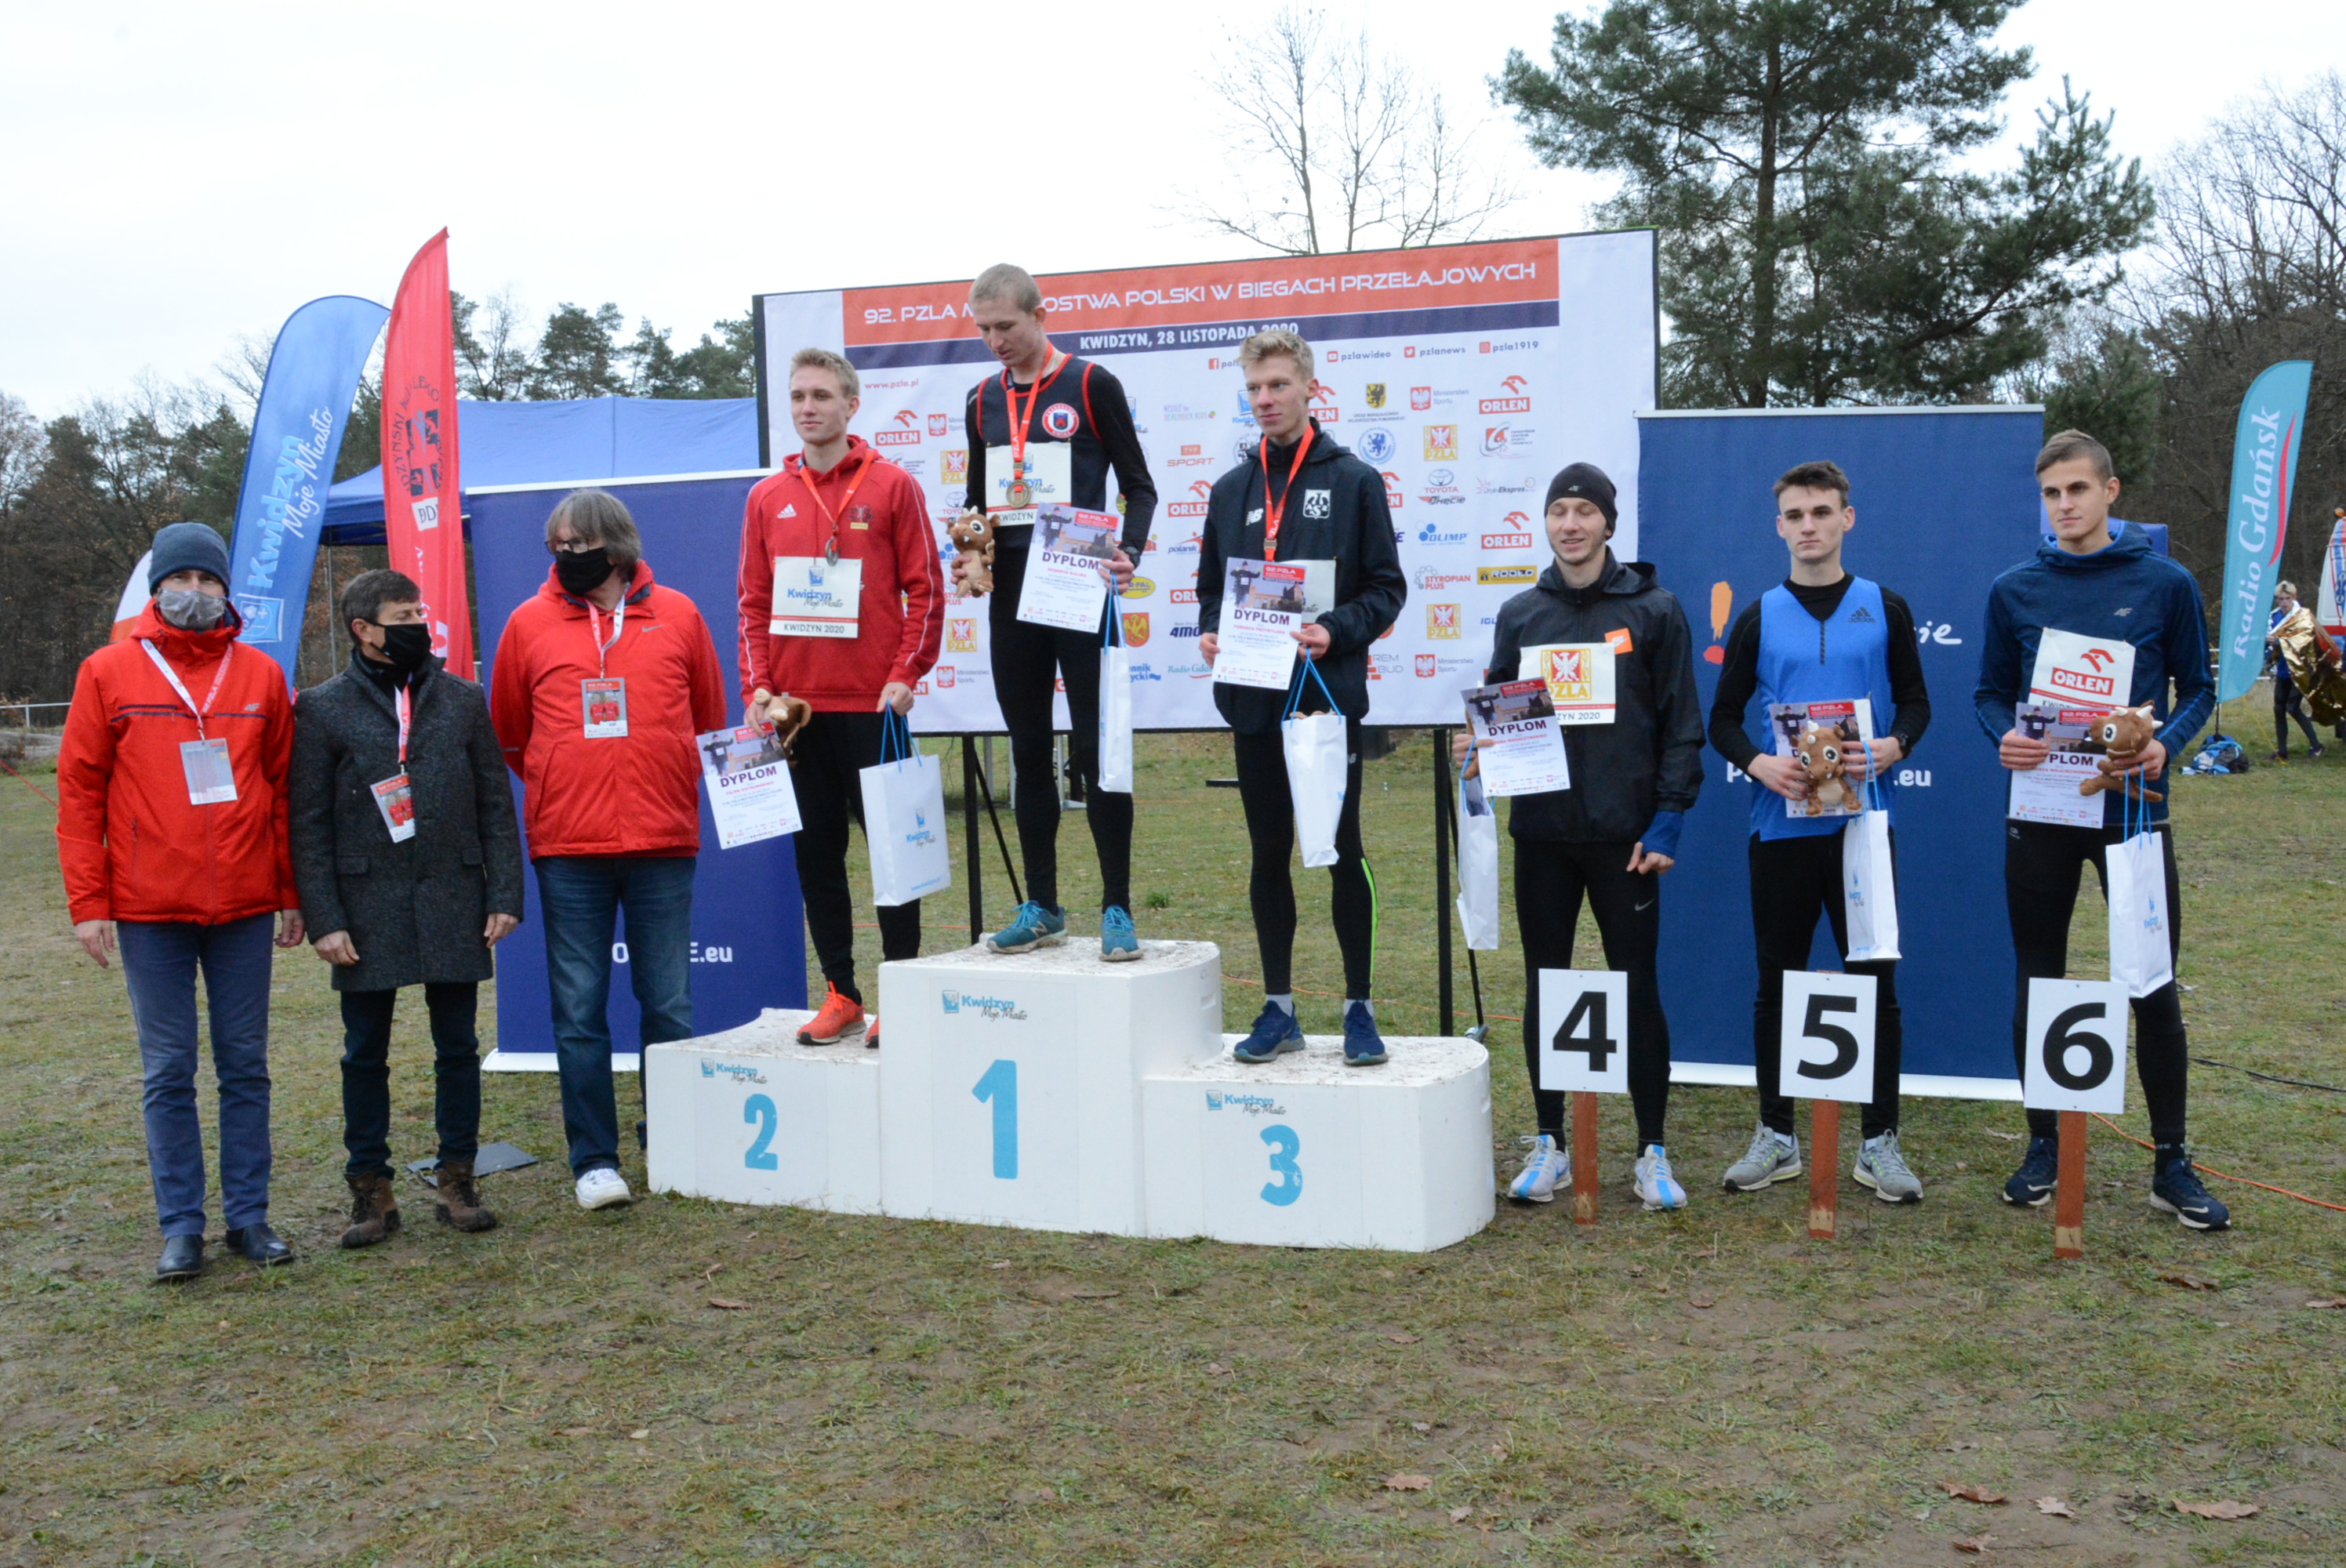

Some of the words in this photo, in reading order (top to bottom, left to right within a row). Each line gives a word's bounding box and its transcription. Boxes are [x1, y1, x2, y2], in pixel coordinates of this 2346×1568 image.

[864, 307, 896, 325] 92.
[901, 303, 957, 321] PZLA
[1126, 285, 1205, 306] POLSKI
[1210, 284, 1233, 300] W
[1238, 276, 1335, 299] BIEGACH
[1342, 262, 1536, 292] PRZEŁAJOWYCH
[1080, 332, 1153, 350] KWIDZYN,
[1157, 331, 1175, 345] 28
[1180, 325, 1256, 343] LISTOPADA
[1419, 346, 1465, 357] pzlanews
[1492, 341, 1538, 353] pzla1919
[1341, 350, 1391, 361] pzlawideo
[1481, 399, 1527, 413] ORLEN
[296, 405, 334, 481] Miasto
[877, 432, 919, 445] ORLEN
[1425, 448, 1457, 460] PZLA
[1167, 458, 1215, 466] SPORT
[2239, 405, 2281, 554] Gdańsk
[248, 435, 304, 590] Kwidzyn
[281, 485, 321, 539] Moje
[1429, 532, 1467, 542] OLIMP
[1484, 535, 1528, 548] ORLEN
[1042, 551, 1099, 570] DYPLOM
[787, 588, 832, 601] Kwidzyn
[1233, 609, 1290, 626] DYPLOM
[2233, 561, 2262, 659] Radio
[784, 623, 822, 633] KWIDZYN
[824, 625, 844, 633] 2020
[1428, 628, 1459, 638] PZLA
[946, 640, 976, 652] PZLA
[1372, 654, 1400, 662] REM
[1168, 665, 1190, 673] Radio
[1378, 665, 1404, 673] BUD
[2054, 670, 2111, 693] ORLEN
[1578, 712, 1600, 720] 2020
[1488, 720, 1547, 737] DYPLOM
[720, 765, 777, 788] DYPLOM
[961, 995, 1015, 1011] Kwidzyn
[1552, 991, 1617, 1073] 4
[1796, 993, 1859, 1080] 5
[2043, 1002, 2115, 1091] 6
[716, 1062, 758, 1076] Kwidzyn
[1224, 1094, 1275, 1108] Kwidzyn
[972, 1059, 1018, 1180] 1
[743, 1093, 778, 1171] 2
[1259, 1124, 1302, 1207] 3
